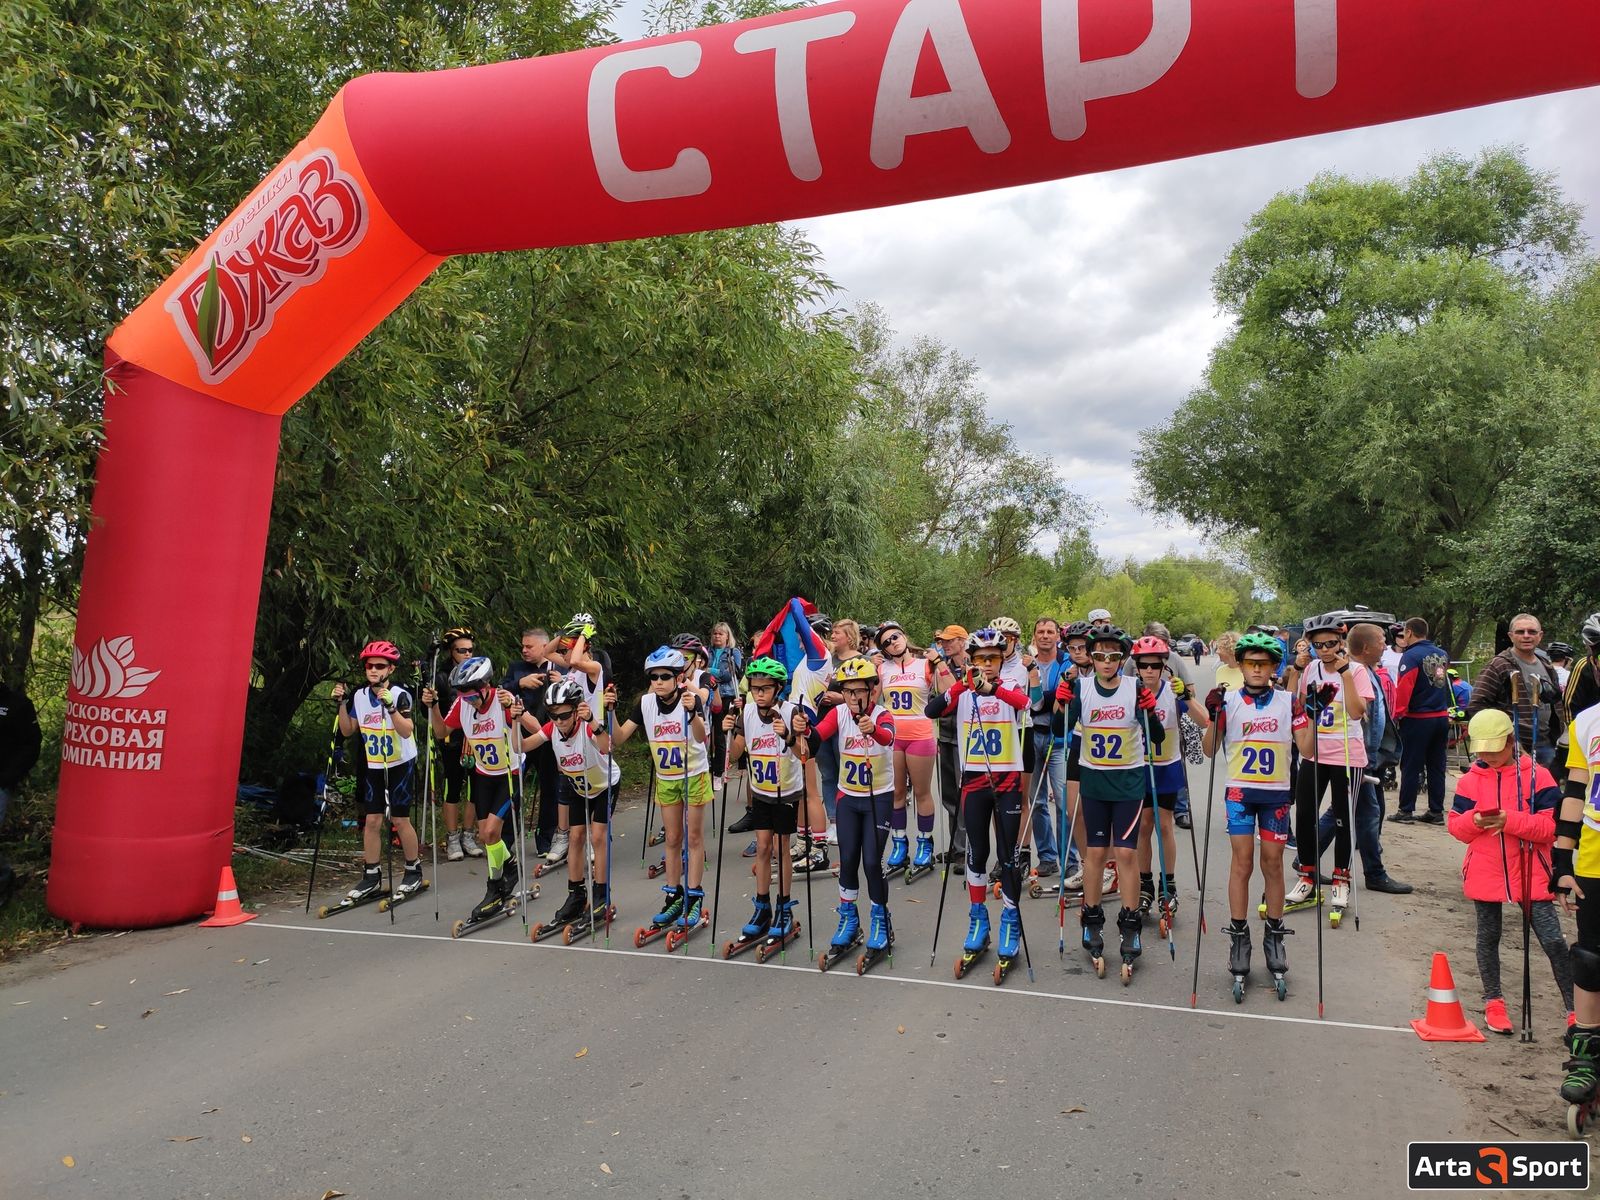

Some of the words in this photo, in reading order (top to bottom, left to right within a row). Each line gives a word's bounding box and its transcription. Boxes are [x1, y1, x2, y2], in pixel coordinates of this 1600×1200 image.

[66, 701, 167, 725] ОСКОВСКАЯ
[890, 691, 912, 710] 39
[474, 743, 499, 765] 23
[969, 728, 1002, 756] 28
[1091, 733, 1123, 759] 32
[62, 744, 162, 770] ОМПАНИЯ
[657, 746, 683, 769] 24
[1241, 747, 1275, 775] 29
[752, 760, 778, 784] 34
[845, 760, 873, 786] 26
